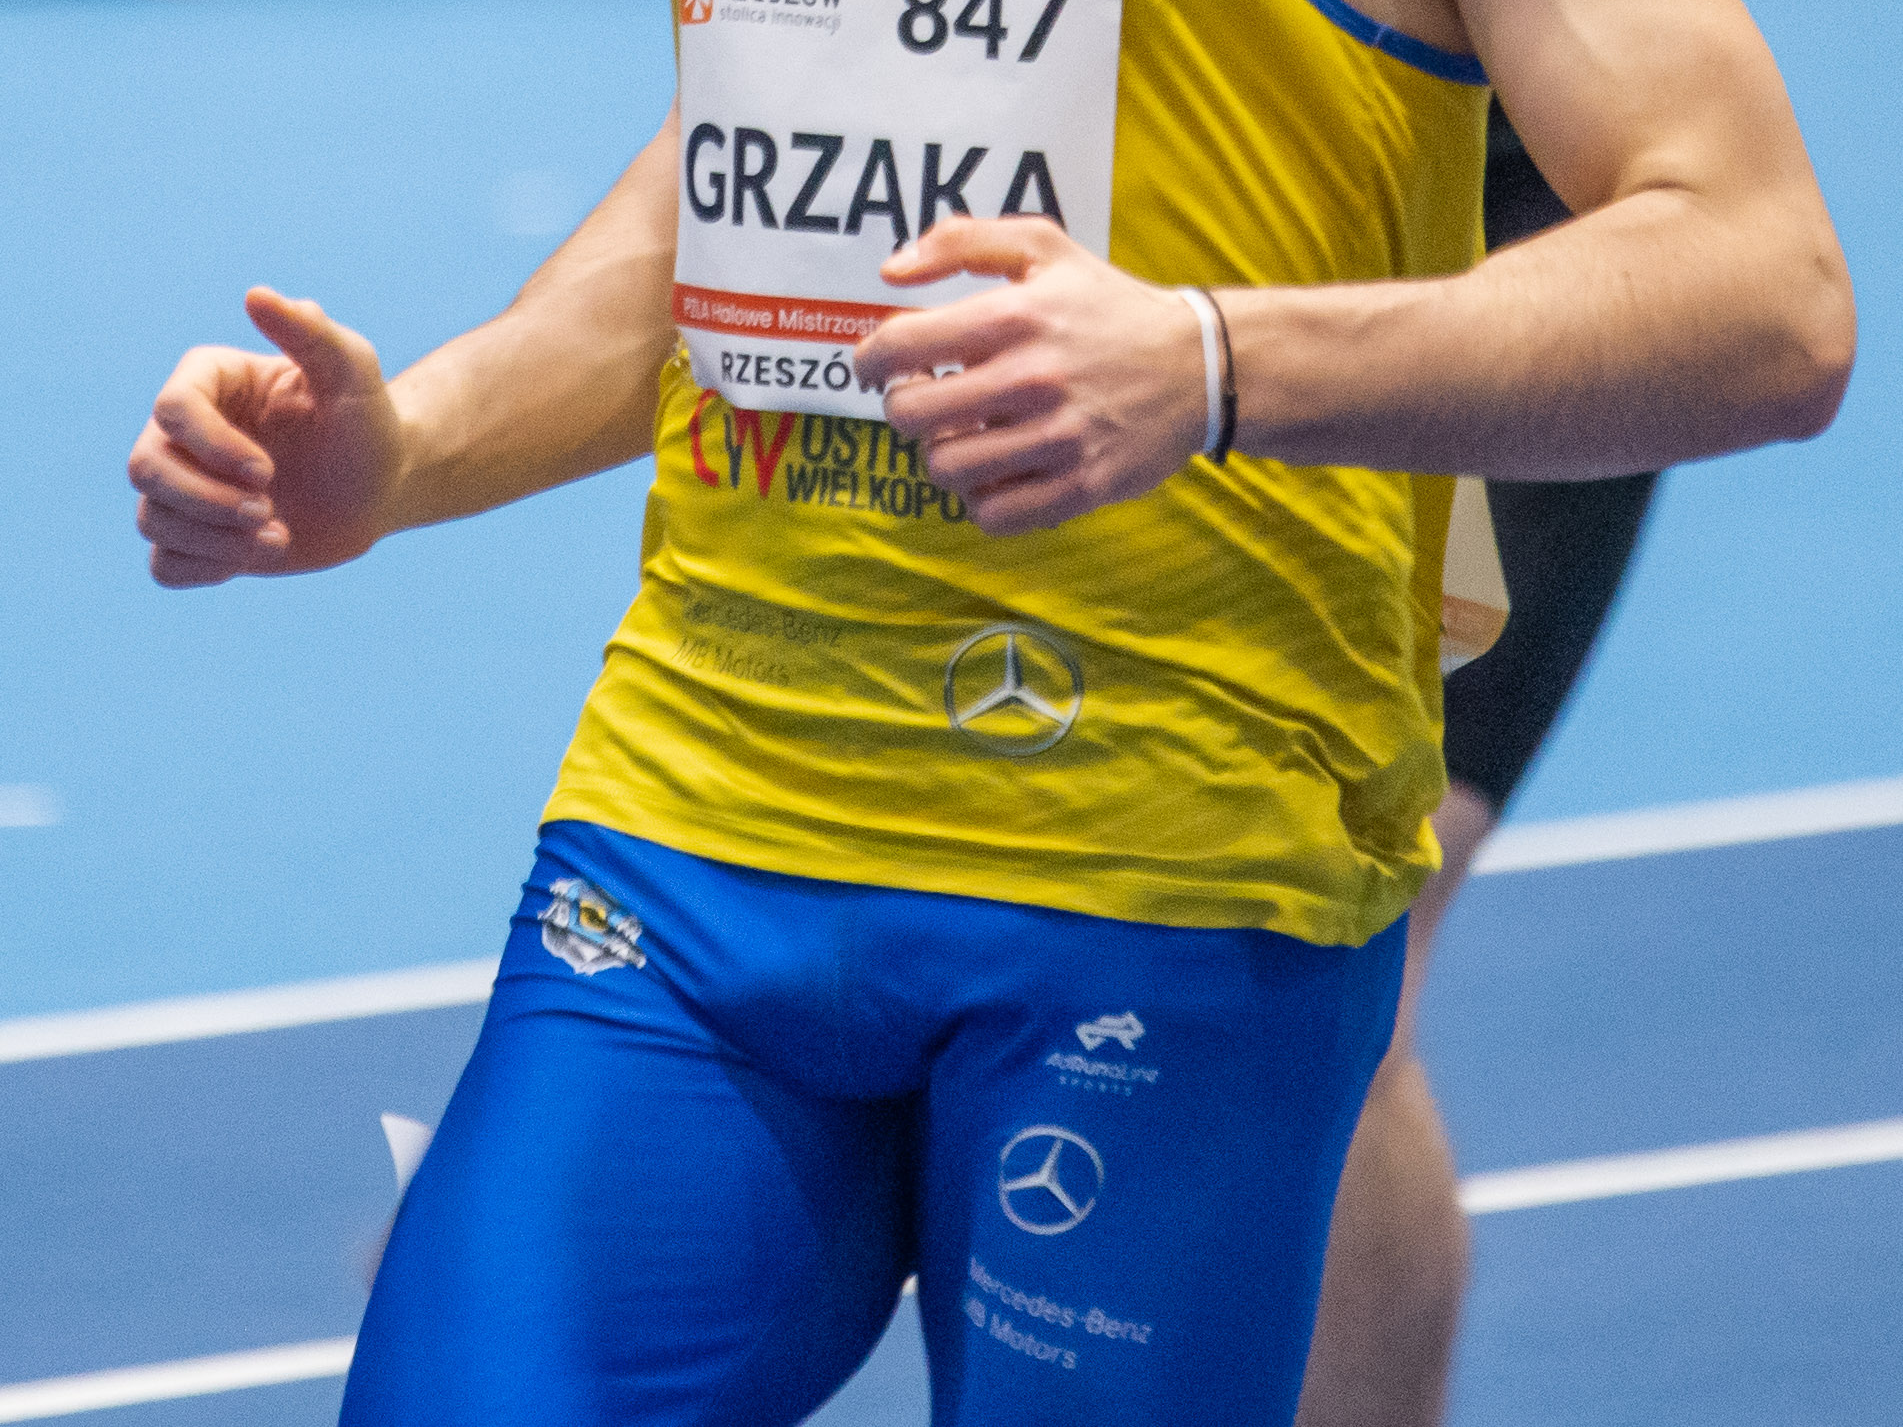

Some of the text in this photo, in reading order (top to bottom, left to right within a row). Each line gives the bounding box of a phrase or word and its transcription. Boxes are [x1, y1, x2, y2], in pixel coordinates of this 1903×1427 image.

[720, 6, 842, 36] stolica innowacji
[686, 122, 1067, 250] GRZĄKA
[711, 303, 773, 329] Halowe
[778, 308, 881, 336] Mistrzost
[721, 350, 884, 395] RZESZÓ
[786, 463, 969, 524] WIELKOPO
